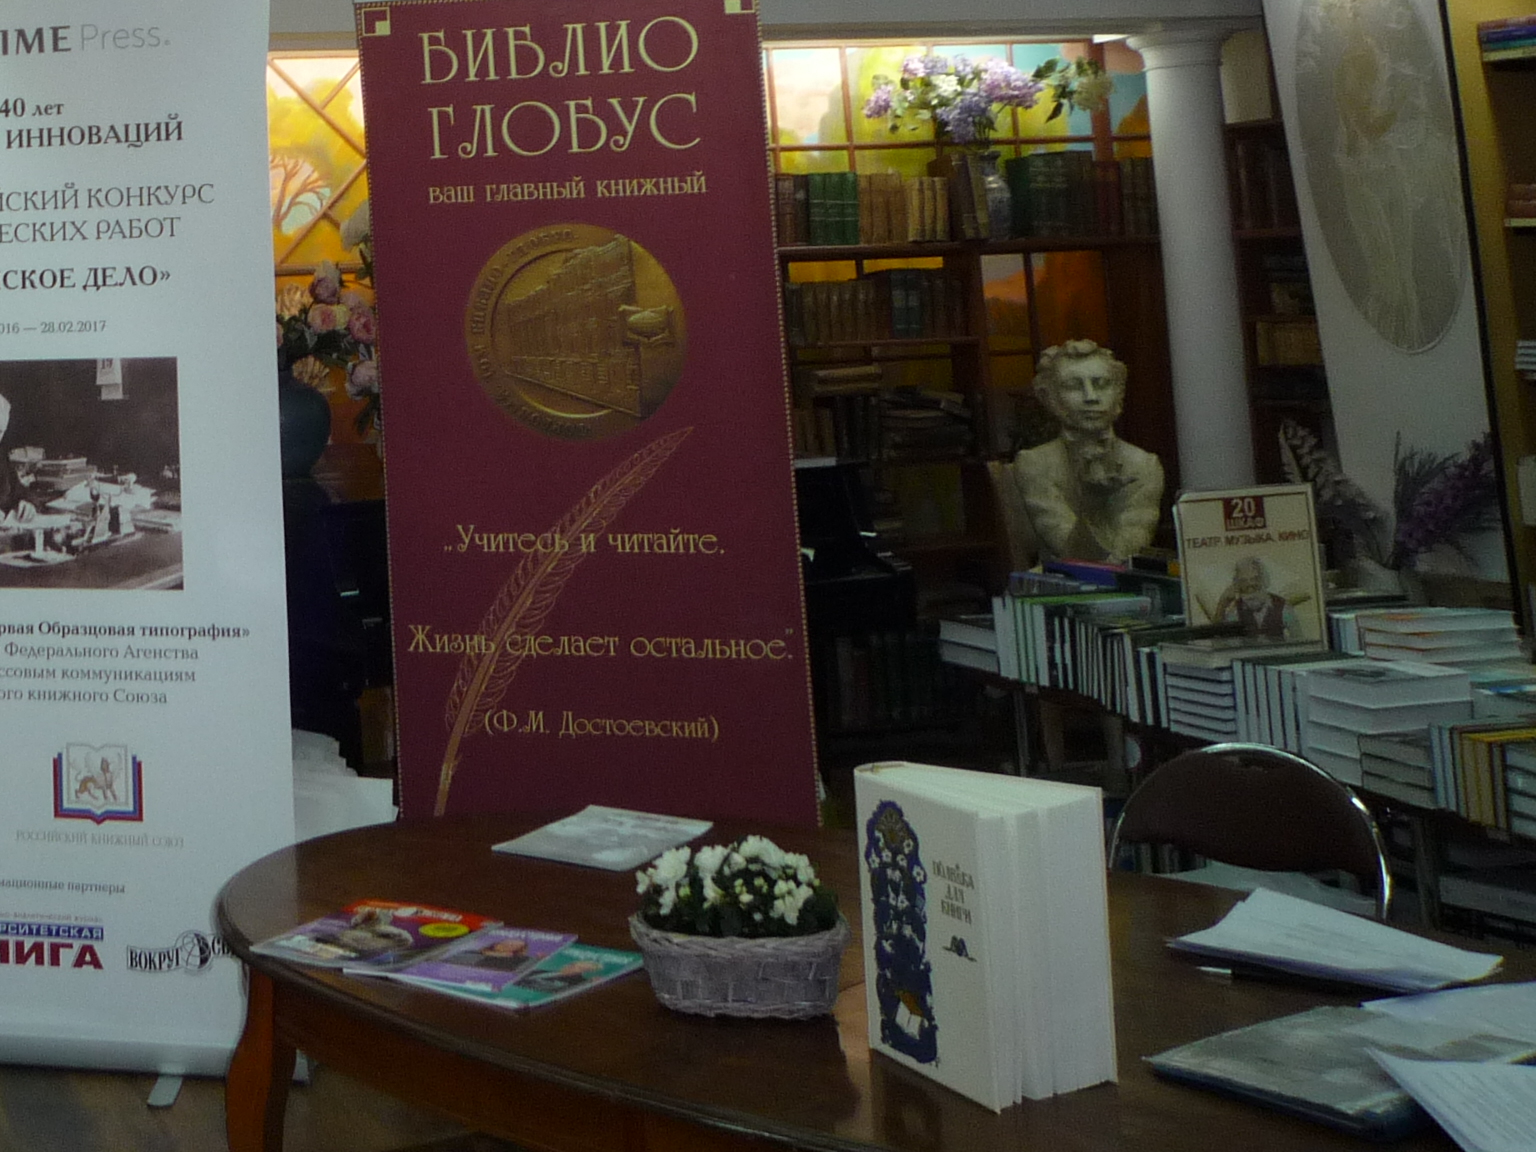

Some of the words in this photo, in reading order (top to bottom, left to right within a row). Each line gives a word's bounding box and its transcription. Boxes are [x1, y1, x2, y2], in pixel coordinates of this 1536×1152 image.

[80, 23, 171, 52] Press.
[418, 15, 700, 85] БИБЛИО
[32, 100, 65, 117] лет
[5, 113, 184, 150] ИННОВАЦИЙ
[427, 91, 702, 160] ГЛОБУС
[87, 182, 215, 209] КОНКУРС
[428, 183, 475, 204] ваш
[485, 176, 586, 203] главный
[596, 170, 708, 198] книжный
[95, 216, 181, 241] РАБОТ
[82, 264, 171, 293] ДЕЛО»
[40, 320, 107, 335] 28.02.2017
[1230, 498, 1256, 518] 20
[579, 533, 597, 553] и
[608, 529, 725, 555] читайте.
[38, 620, 135, 638] Образцовая
[140, 623, 250, 641] типография»
[407, 624, 496, 654] Жизнь
[505, 633, 619, 658] сделает
[4, 641, 119, 660] Федерального
[123, 645, 199, 660] Агенства
[61, 668, 196, 684] коммуникациям
[27, 689, 109, 703] книжного
[113, 688, 168, 704] Союза
[558, 711, 720, 743] Достоевский)
[67, 880, 126, 896] партнеры
[129, 946, 181, 972] ВОКРУГ
